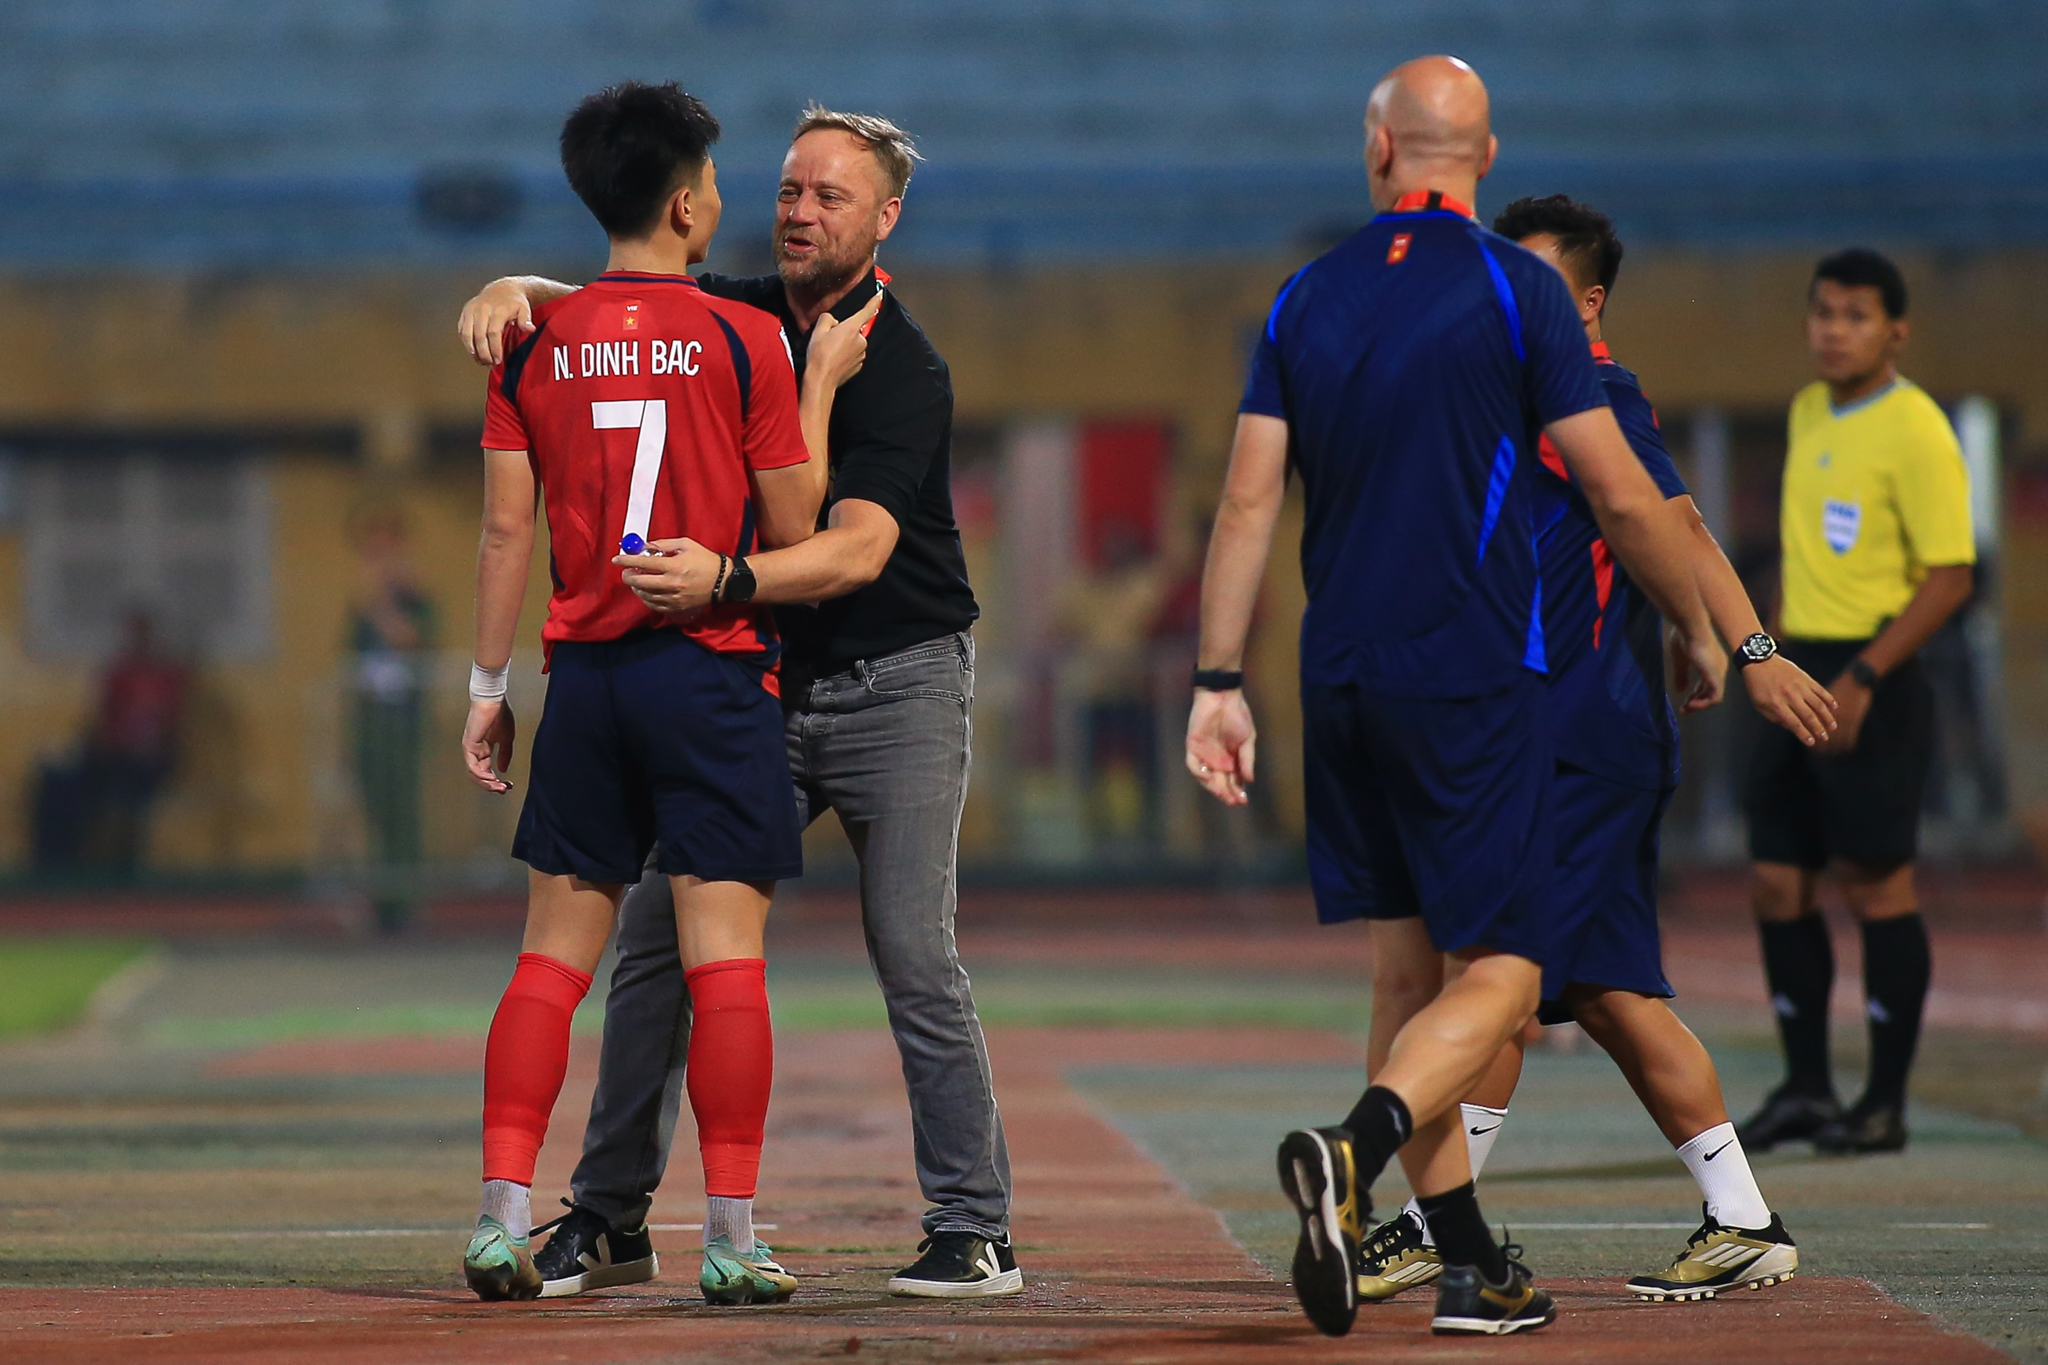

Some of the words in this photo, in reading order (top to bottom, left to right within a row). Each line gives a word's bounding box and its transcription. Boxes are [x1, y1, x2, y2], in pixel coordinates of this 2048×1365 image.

[553, 345, 574, 381] N.
[581, 340, 639, 378] DINH
[651, 339, 702, 376] BAC
[591, 400, 667, 556] 7
